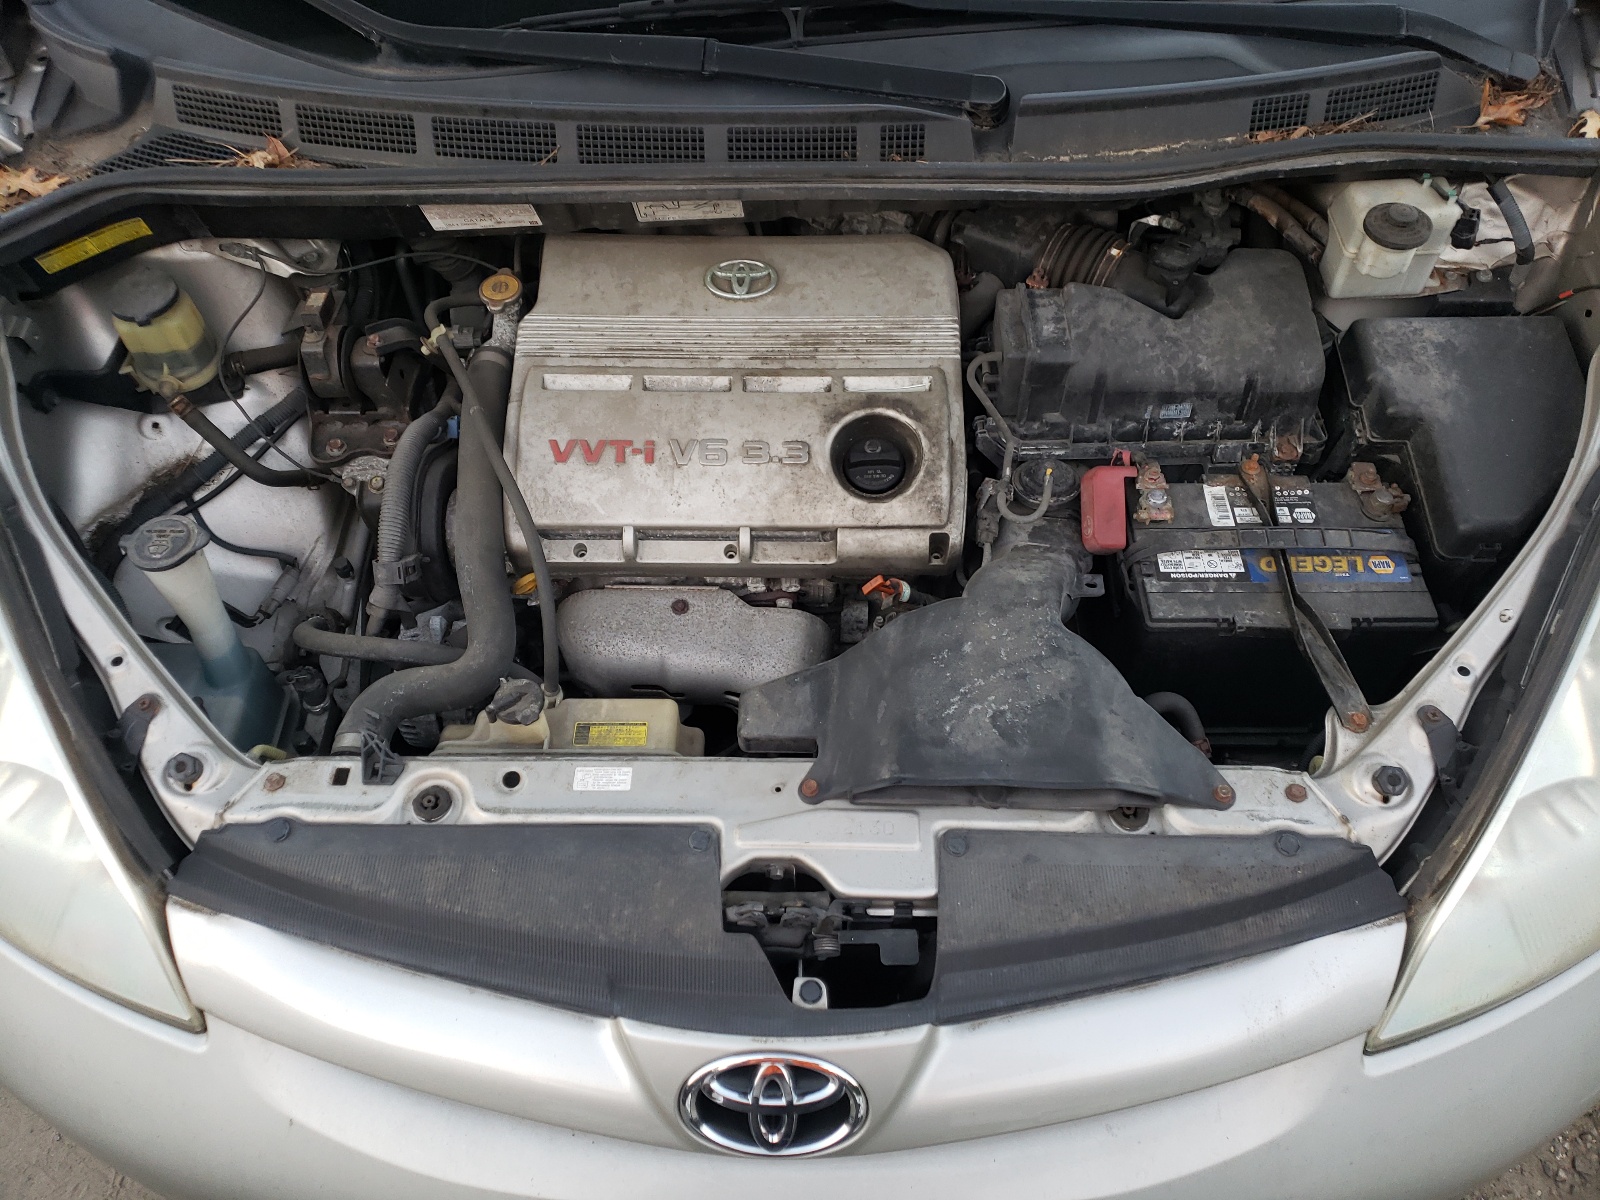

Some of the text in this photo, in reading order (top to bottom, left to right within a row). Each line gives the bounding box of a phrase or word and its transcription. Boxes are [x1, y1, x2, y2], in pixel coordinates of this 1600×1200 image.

[548, 438, 810, 466] VVT-i V6 3.3
[1371, 560, 1391, 569] NAPA
